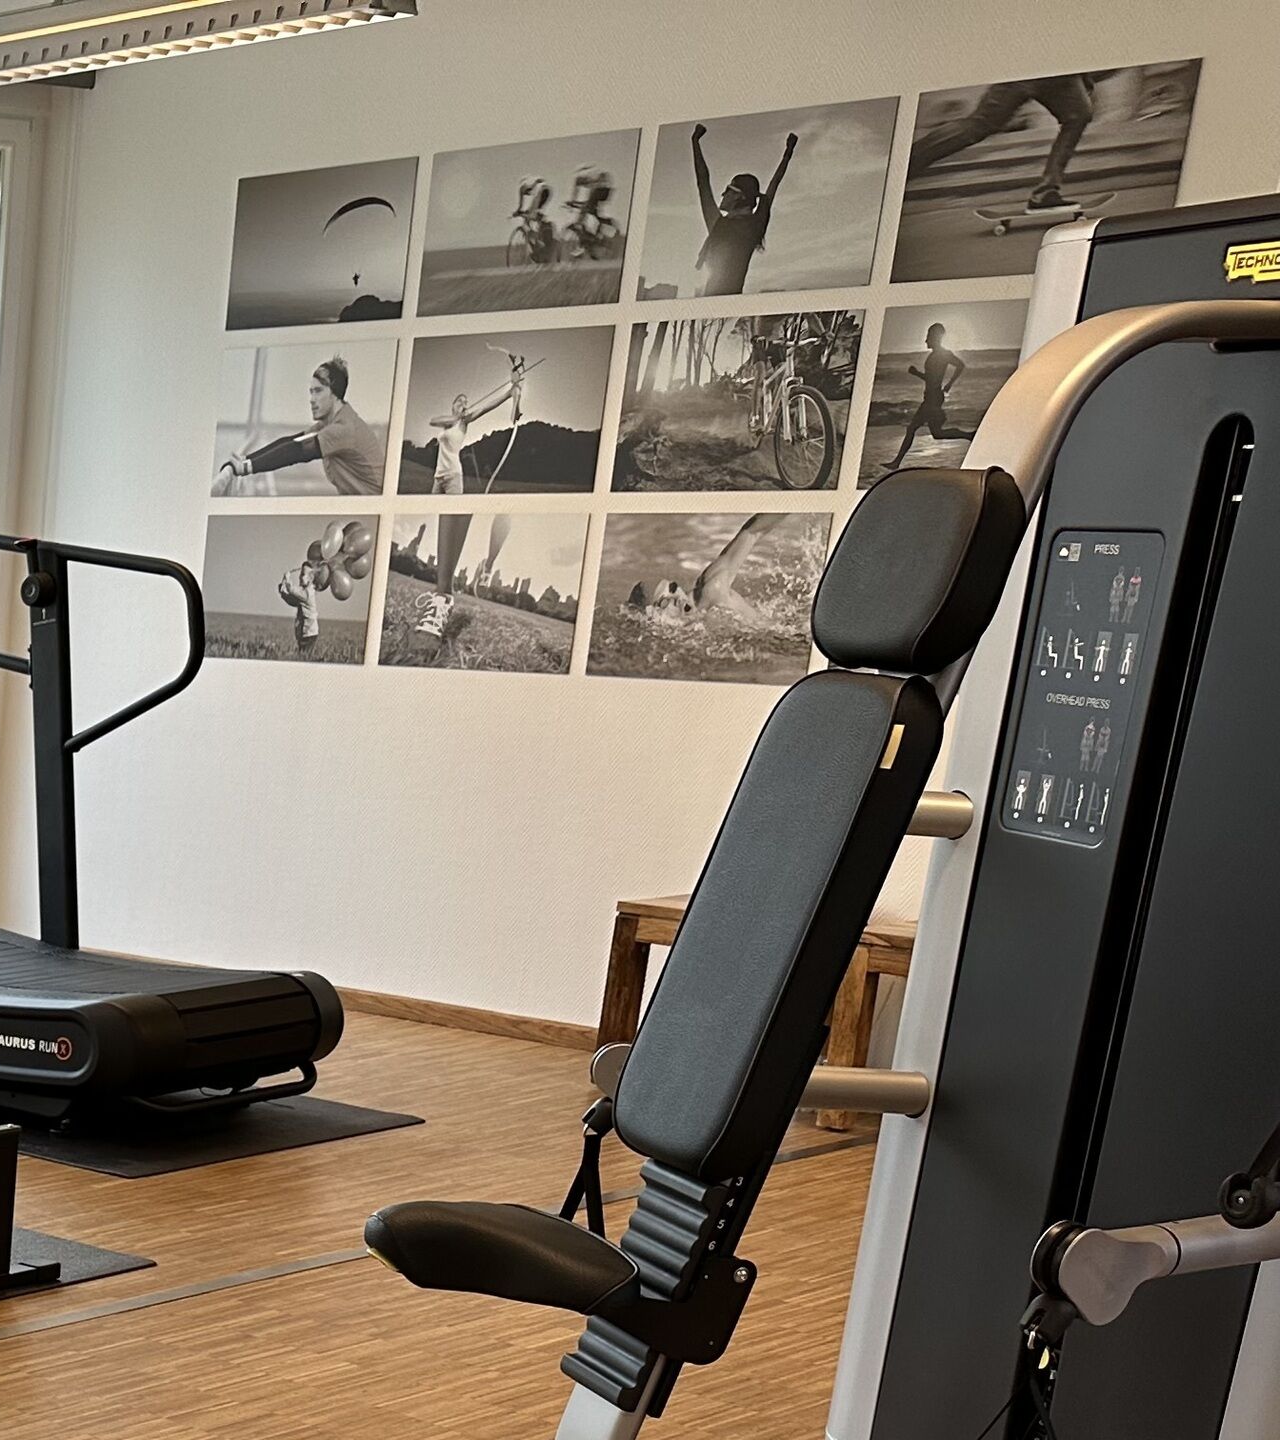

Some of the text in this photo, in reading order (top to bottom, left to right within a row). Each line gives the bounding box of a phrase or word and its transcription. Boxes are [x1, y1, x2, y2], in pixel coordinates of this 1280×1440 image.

[1094, 543, 1120, 555] PRESS
[1046, 692, 1110, 710] OVERHEAD PRESS
[39, 1040, 58, 1054] RUN
[736, 1176, 744, 1187] 3
[726, 1198, 735, 1208] 4
[717, 1219, 726, 1230] 5
[708, 1240, 717, 1251] 6
